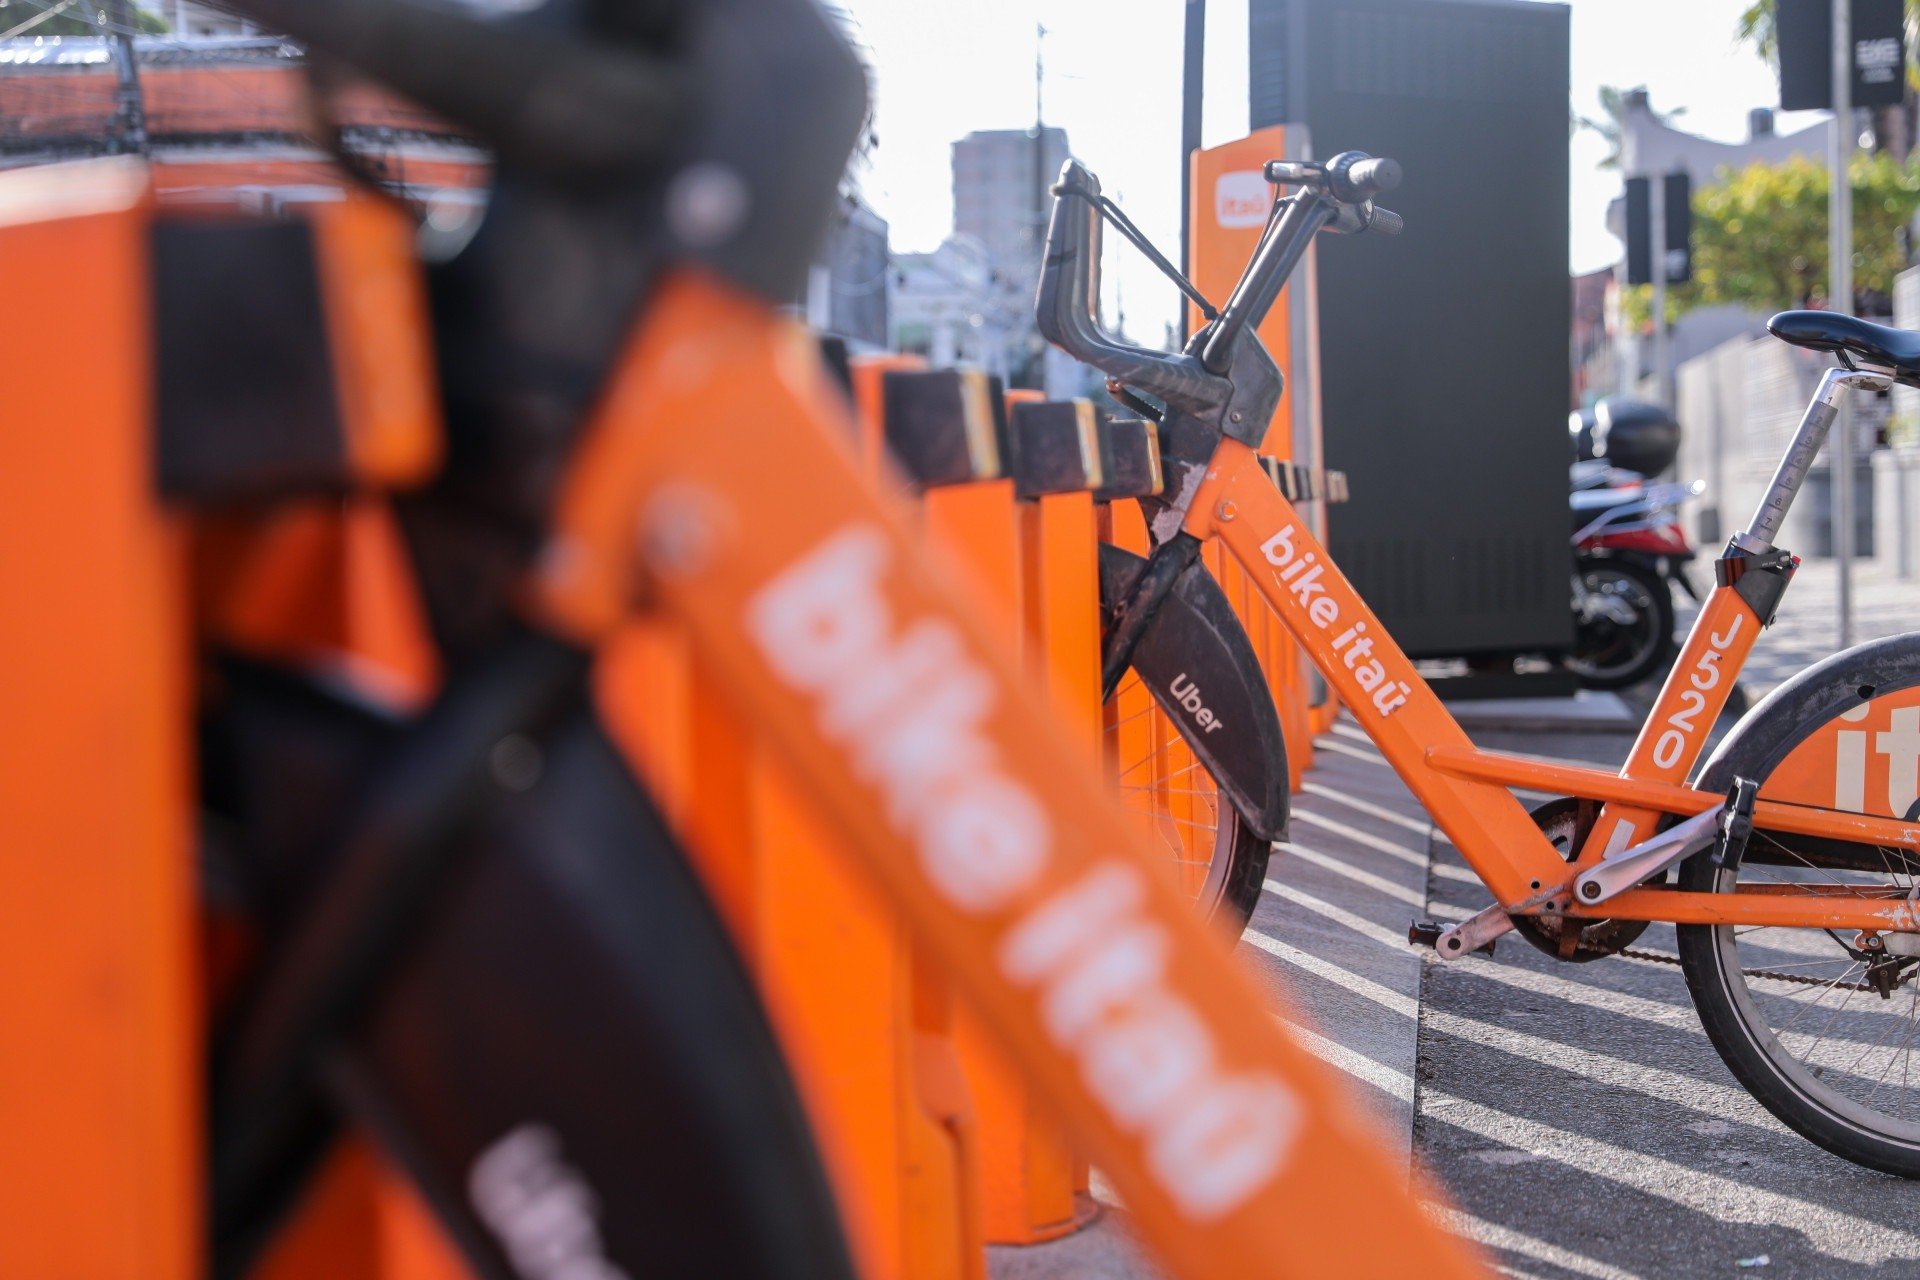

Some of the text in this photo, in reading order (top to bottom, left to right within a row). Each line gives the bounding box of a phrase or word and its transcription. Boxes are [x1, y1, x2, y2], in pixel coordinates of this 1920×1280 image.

[1169, 672, 1223, 734] Uber
[1259, 524, 1412, 718] bike itaú
[1653, 613, 1744, 769] J520
[748, 524, 1054, 912] bike
